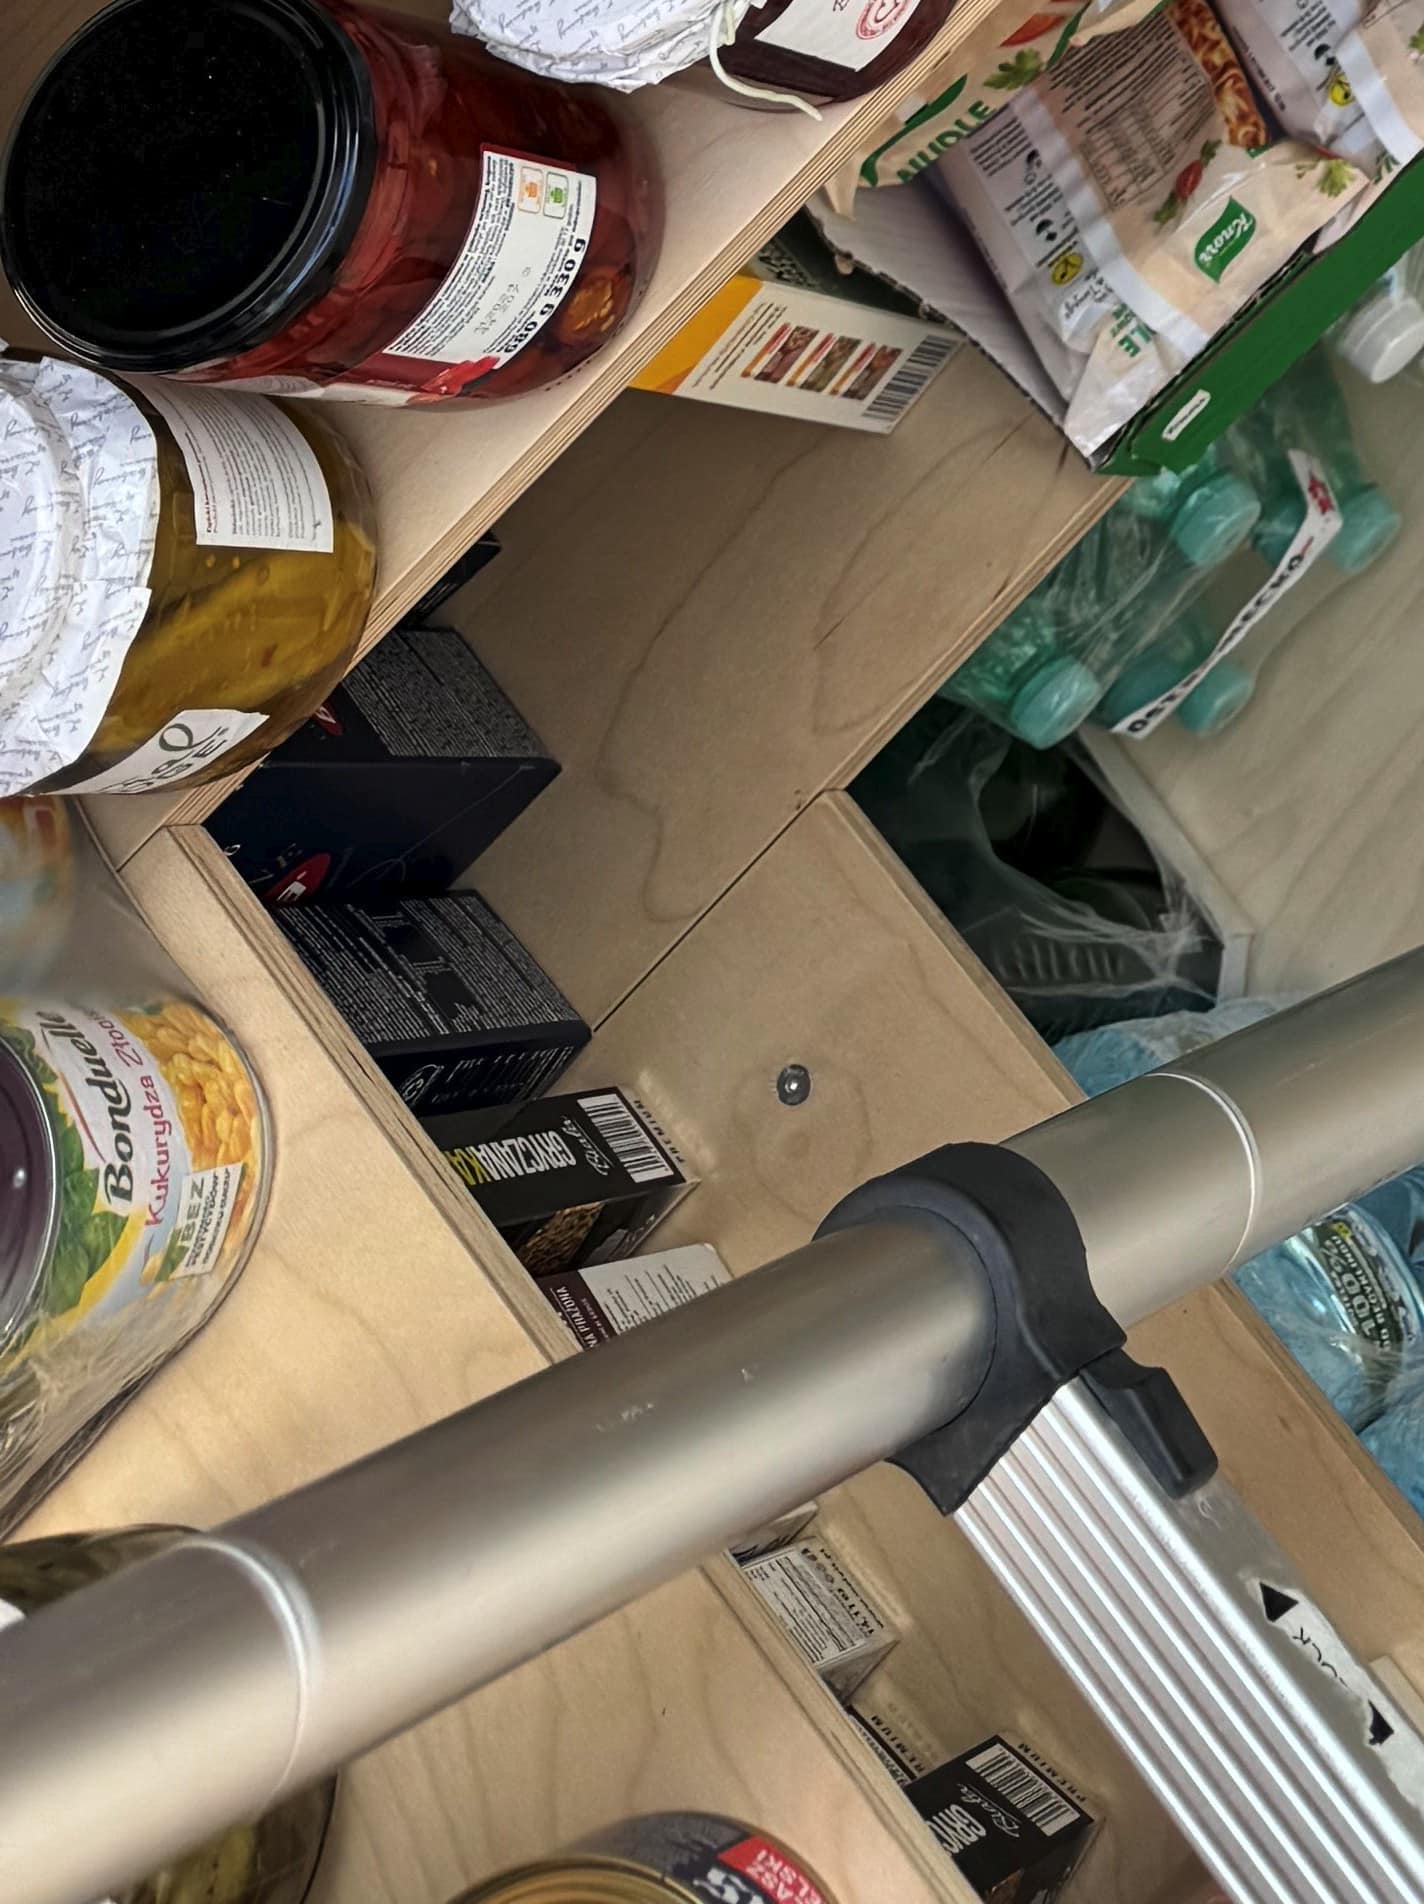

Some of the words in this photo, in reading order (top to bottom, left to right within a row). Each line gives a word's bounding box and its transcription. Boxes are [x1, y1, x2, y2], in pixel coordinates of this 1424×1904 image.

[1198, 208, 1256, 268] Knorr
[37, 1009, 135, 1207] Bonduelle
[139, 1072, 174, 1229] Kukurydza
[471, 1129, 577, 1181] GRYCZANA
[181, 1176, 206, 1247] BEZ
